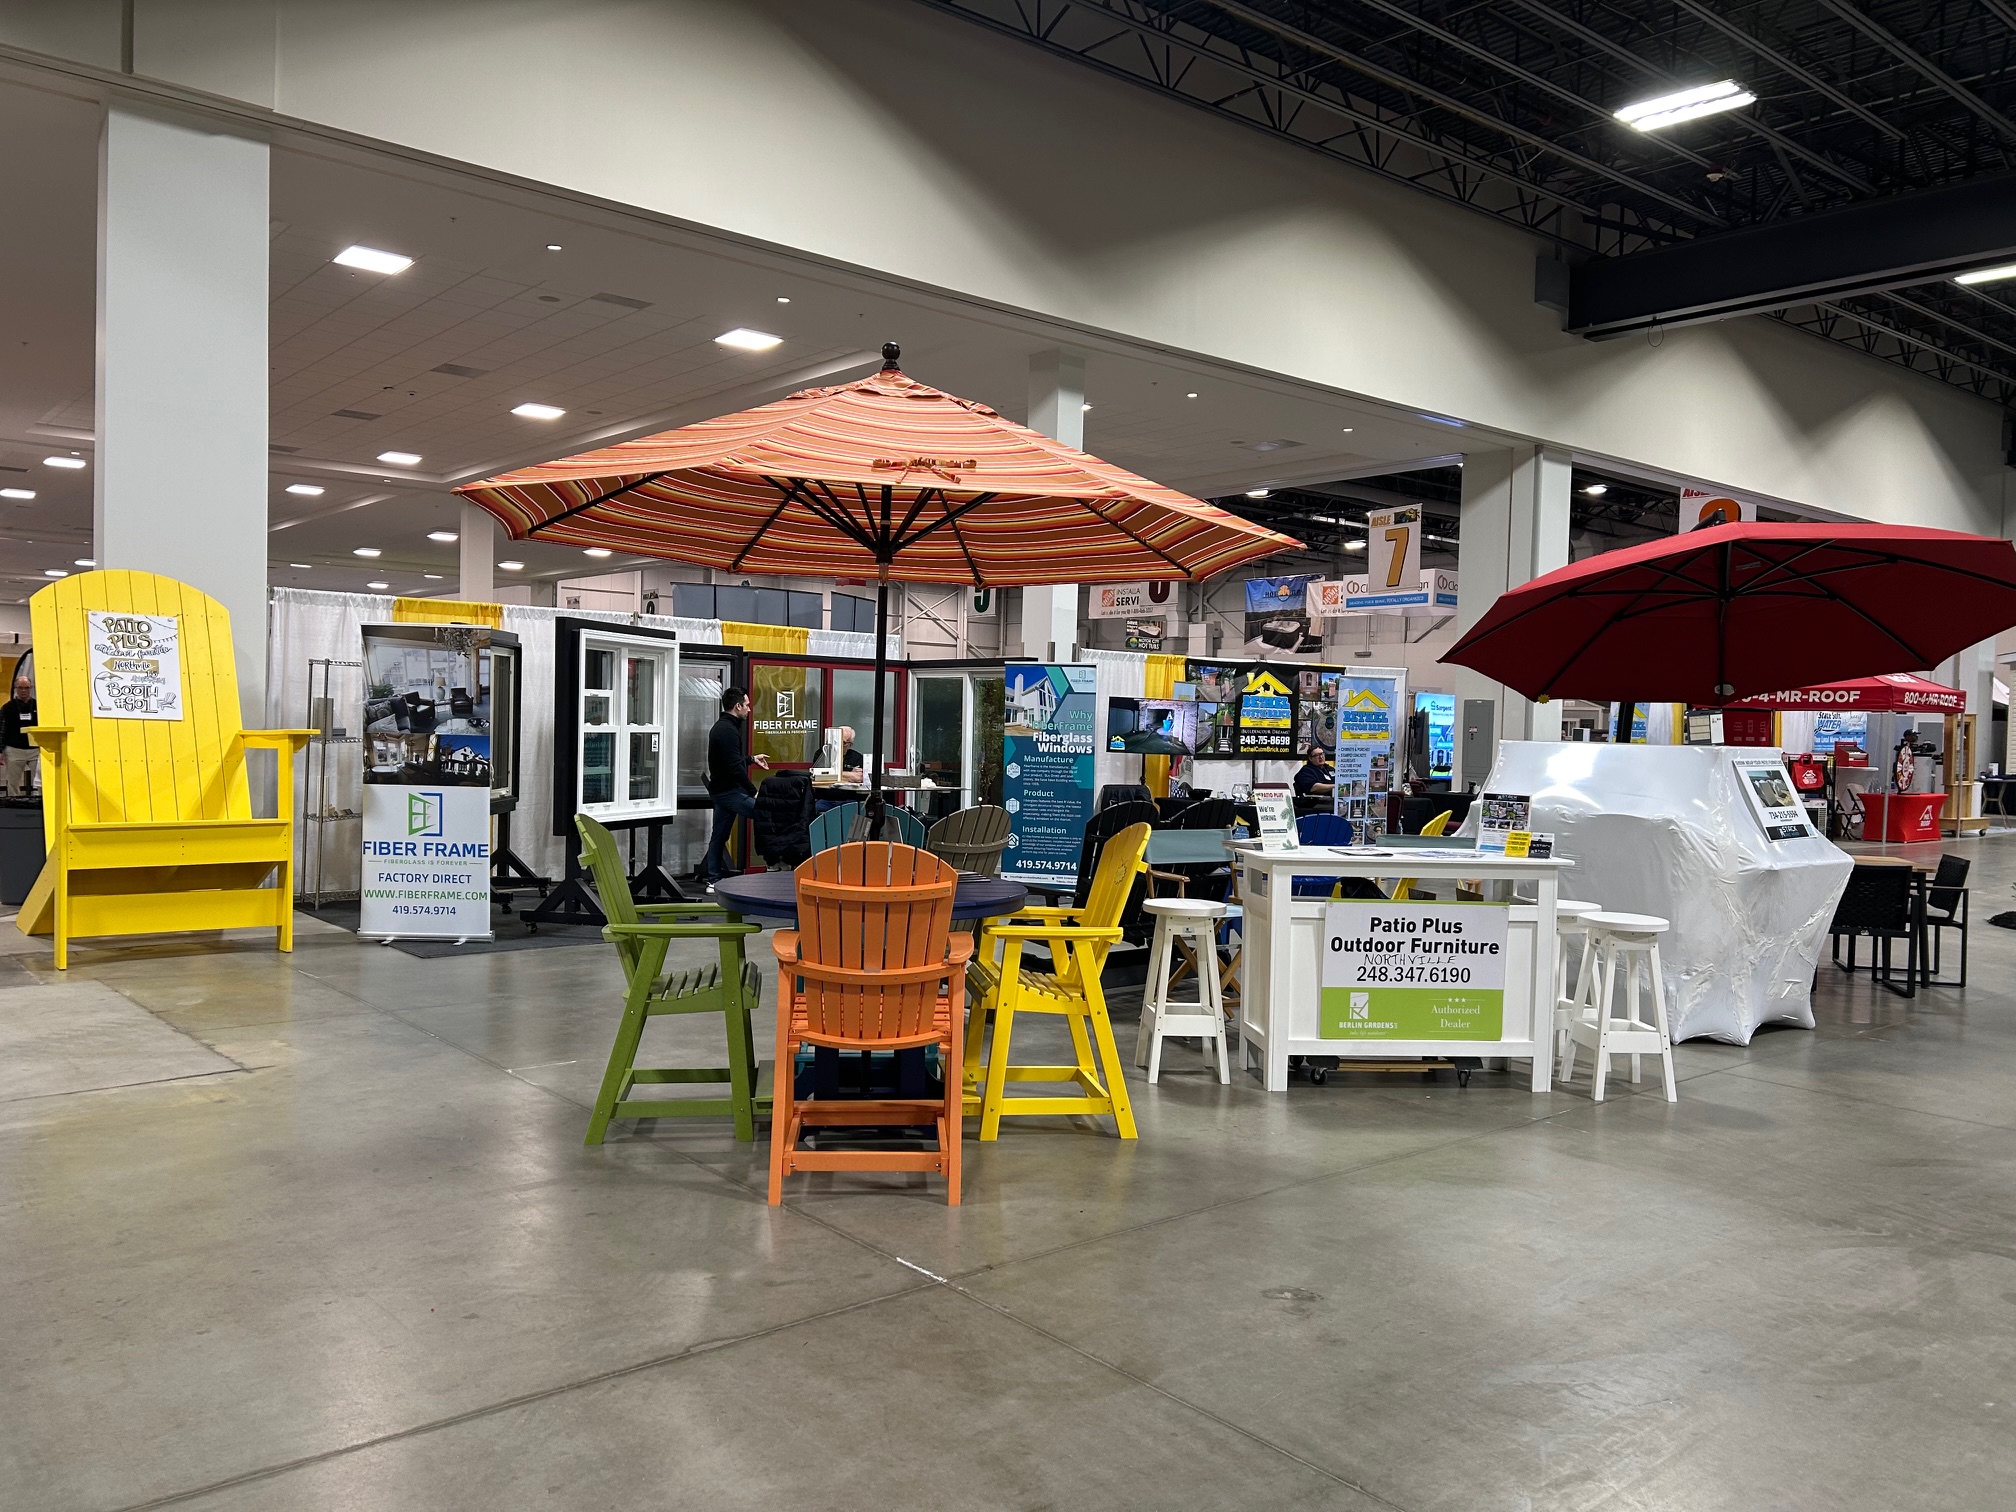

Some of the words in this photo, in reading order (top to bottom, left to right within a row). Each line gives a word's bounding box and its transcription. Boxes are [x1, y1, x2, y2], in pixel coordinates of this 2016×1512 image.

[1371, 515, 1391, 527] AISLE
[1385, 527, 1409, 587] 7
[102, 616, 152, 634] PATIO
[107, 634, 153, 649] PLUS
[106, 682, 158, 698] BOOTH
[1243, 695, 1290, 709] BETHEL
[1069, 711, 1092, 720] Why
[1343, 711, 1388, 723] BETHEL
[754, 721, 782, 730] FIBER
[785, 720, 818, 729] FRAME
[1818, 720, 1842, 729] WATER
[1033, 732, 1092, 744] Fiberglass
[1038, 743, 1092, 753] Windows
[1024, 755, 1073, 763] Manufacture
[1022, 826, 1066, 834] Installation
[363, 841, 417, 856] FIBER
[423, 842, 489, 858] FRAME
[1016, 860, 1077, 871] 419.574.9714
[379, 873, 429, 882] FACTORY
[433, 874, 472, 884] DIRECT
[364, 889, 487, 900] WWW.FIBERFRAME.COM
[392, 905, 456, 915] 419.574.9714
[1370, 917, 1417, 933] Patio
[1422, 917, 1463, 933] Plus
[1331, 936, 1405, 953] Outdoor
[1411, 938, 1500, 954] Furniture
[1364, 953, 1457, 967] NORTHVILLE
[1356, 966, 1471, 983] 248.347.6190
[1431, 1005, 1480, 1015] Authorized
[1339, 1021, 1362, 1029] BERLIN
[1364, 1021, 1394, 1029] GARDENS
[1440, 1018, 1471, 1028] Dealer
